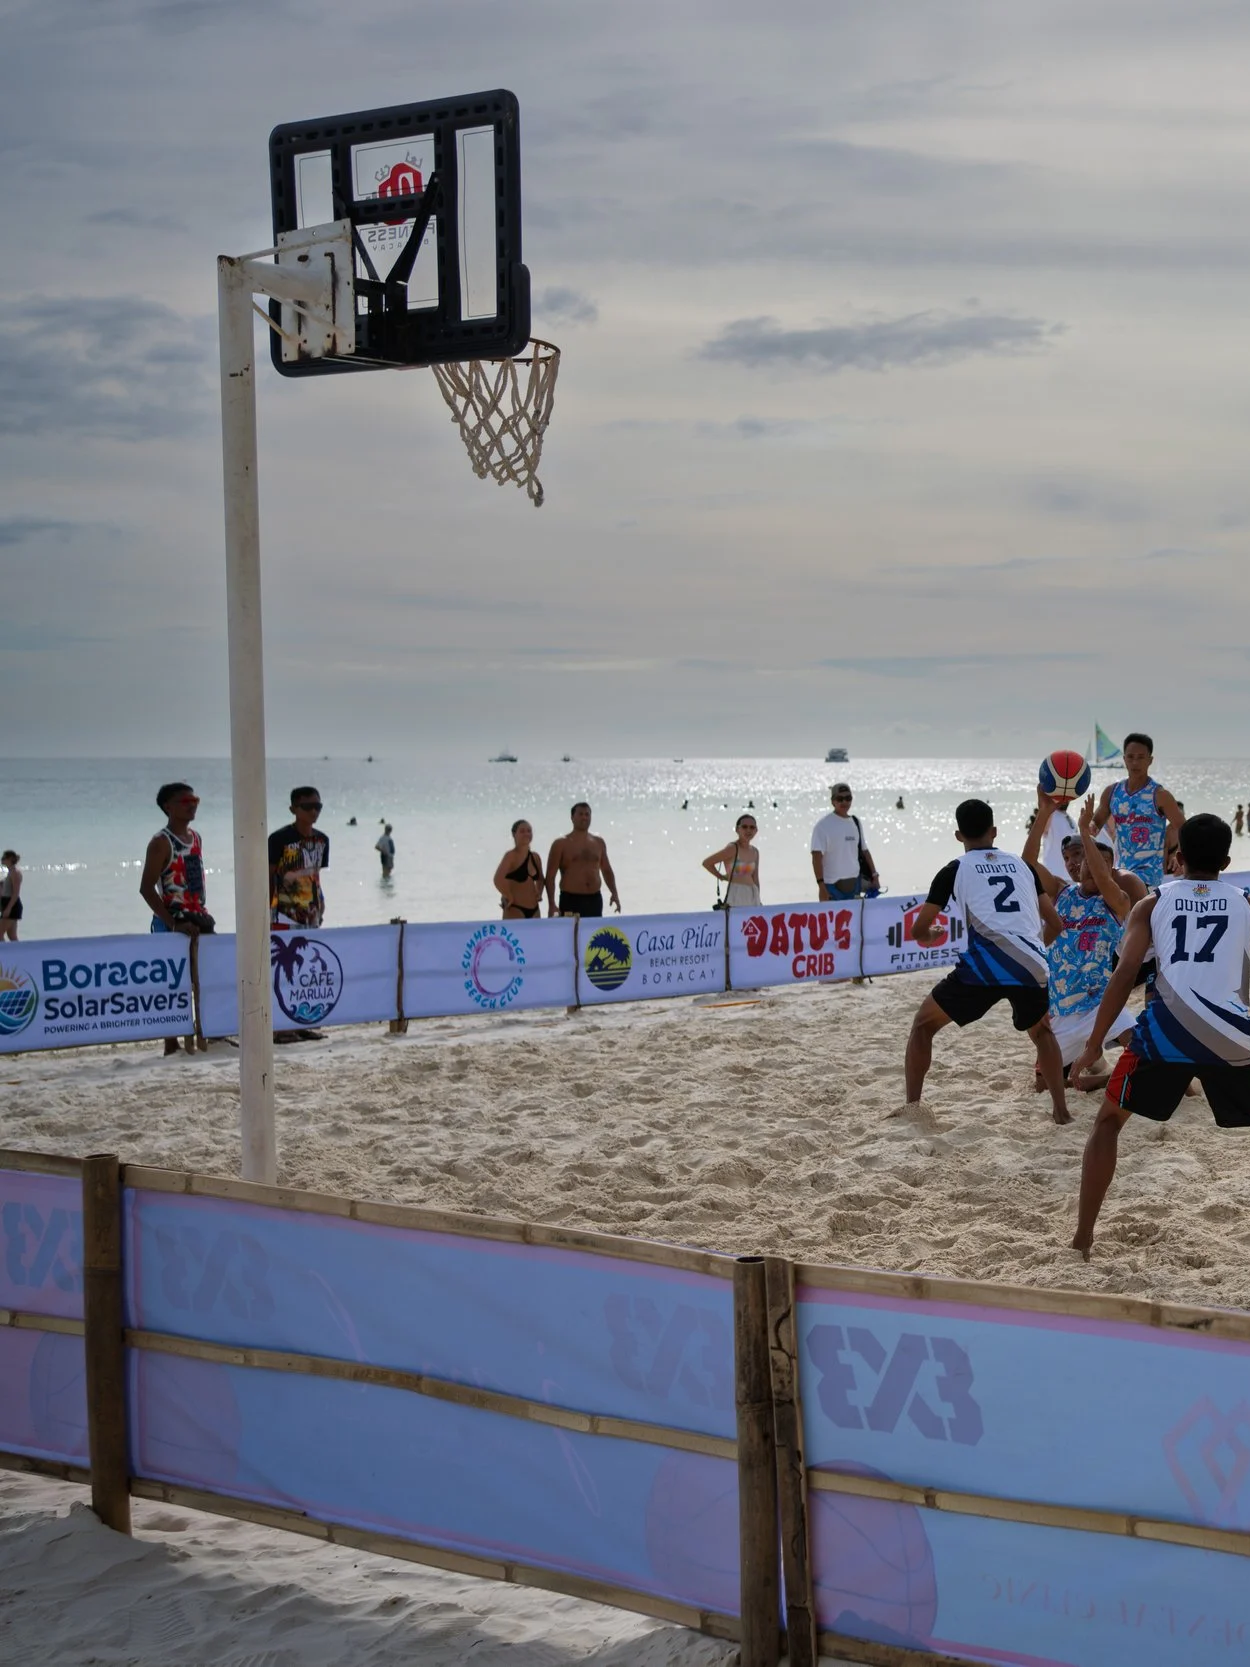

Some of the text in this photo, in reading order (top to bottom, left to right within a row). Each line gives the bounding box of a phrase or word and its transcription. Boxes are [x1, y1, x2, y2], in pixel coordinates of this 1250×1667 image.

[975, 863, 1017, 874] QUINTO
[988, 875, 1021, 912] 2
[1175, 898, 1227, 912] QUINTO
[461, 924, 526, 969] SUMMER PLACE
[636, 923, 721, 955] Casa Pilar
[1170, 915, 1229, 964] 17
[650, 954, 710, 967] BEACH RESORT
[792, 953, 835, 978] CRIB
[891, 948, 960, 964] FITNESS
[42, 957, 187, 991] Boracay
[299, 972, 335, 988] CAFE
[642, 968, 716, 985] BORACAY
[289, 987, 335, 1002] MARUJA
[464, 976, 524, 1009] BEACH CLUB
[44, 992, 189, 1021] SolarSavers
[44, 1022, 90, 1035] POWERING
[100, 1019, 141, 1030] BRIGHTER
[142, 1014, 189, 1025] TOMORROW
